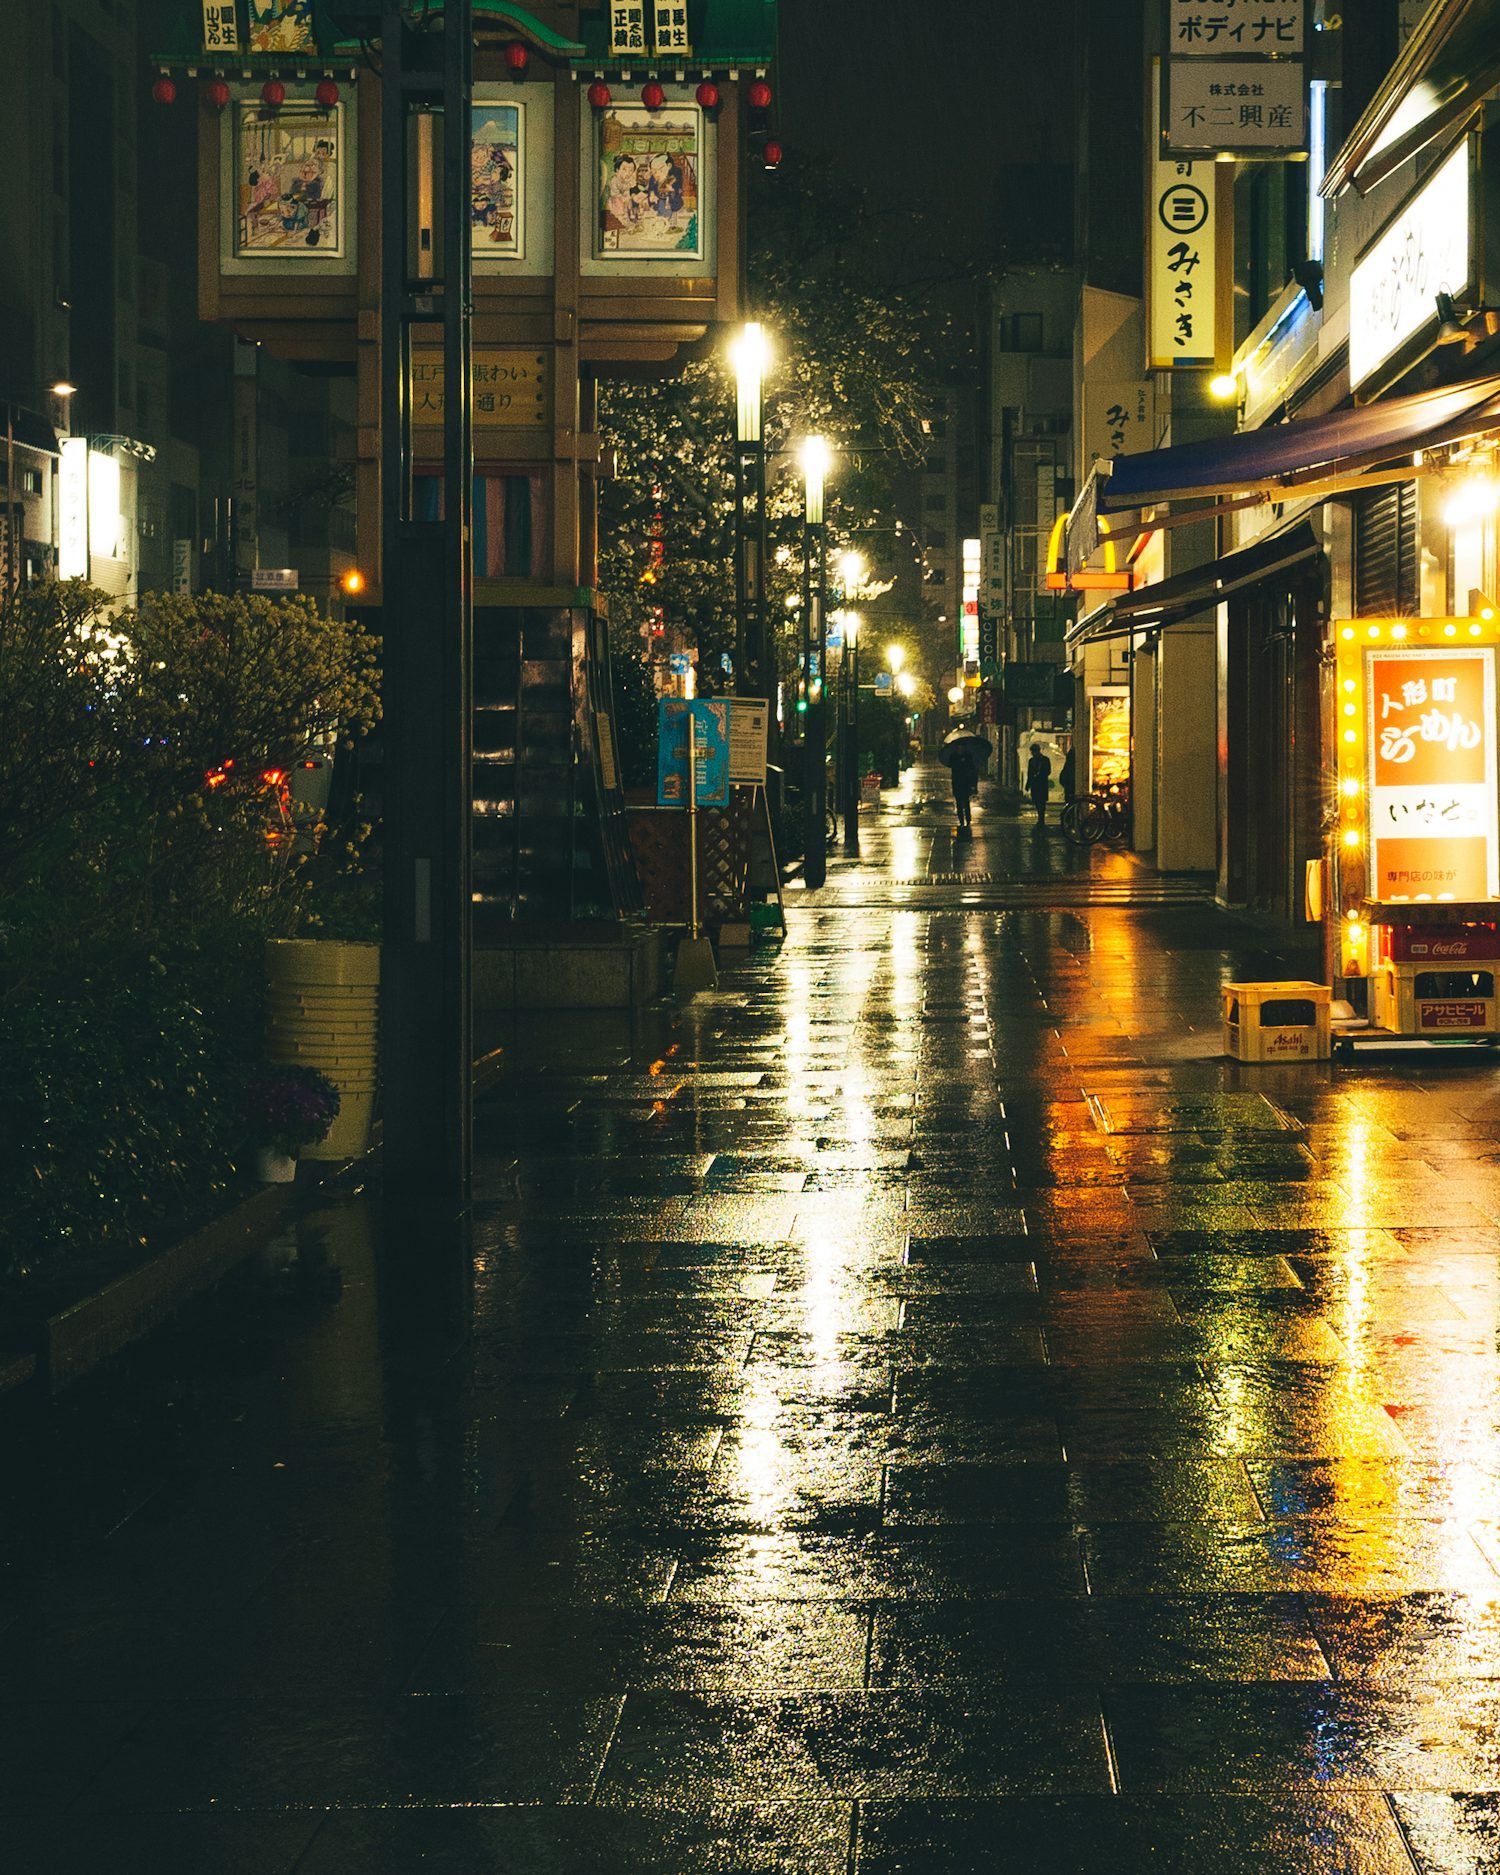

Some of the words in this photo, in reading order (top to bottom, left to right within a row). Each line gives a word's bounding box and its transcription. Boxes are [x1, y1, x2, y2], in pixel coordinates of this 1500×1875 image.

[1178, 15, 1297, 42] ボディナビ
[1209, 83, 1265, 97] 株式会社
[1179, 104, 1293, 129] 不二興産
[1166, 241, 1201, 347] みさき
[1381, 677, 1458, 719] 人形町
[1380, 708, 1482, 763] らーめん
[1387, 871, 1457, 882] 専門店の味が
[1423, 1004, 1485, 1016] アサヒビール
[1274, 1033, 1303, 1046] Asahi
